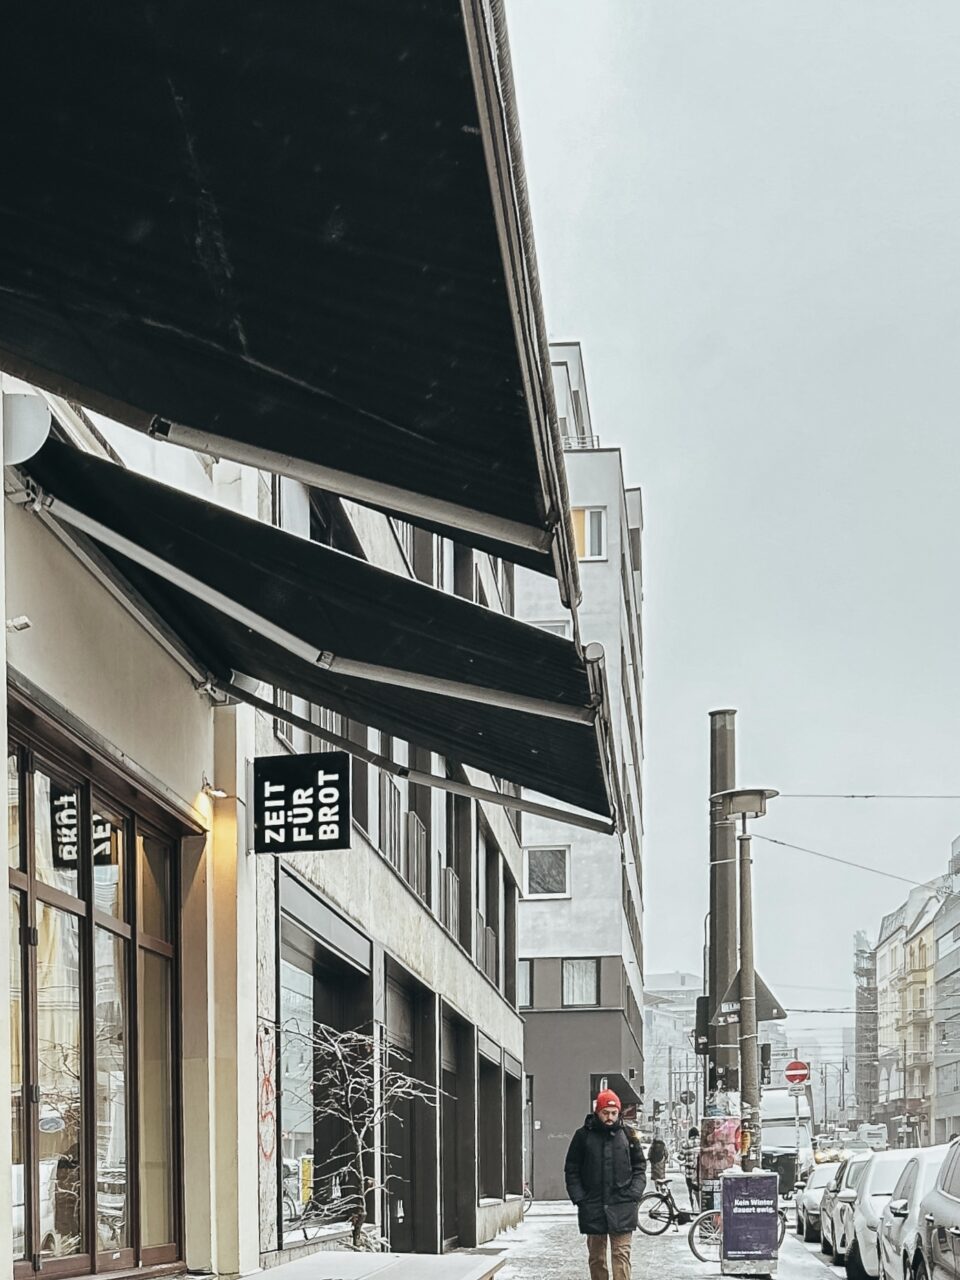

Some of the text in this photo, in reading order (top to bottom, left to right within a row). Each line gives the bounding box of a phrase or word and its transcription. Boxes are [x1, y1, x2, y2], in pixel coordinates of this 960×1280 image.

[264, 781, 285, 843] ZEIT
[287, 787, 313, 842] FÜR
[318, 770, 339, 840] BROT
